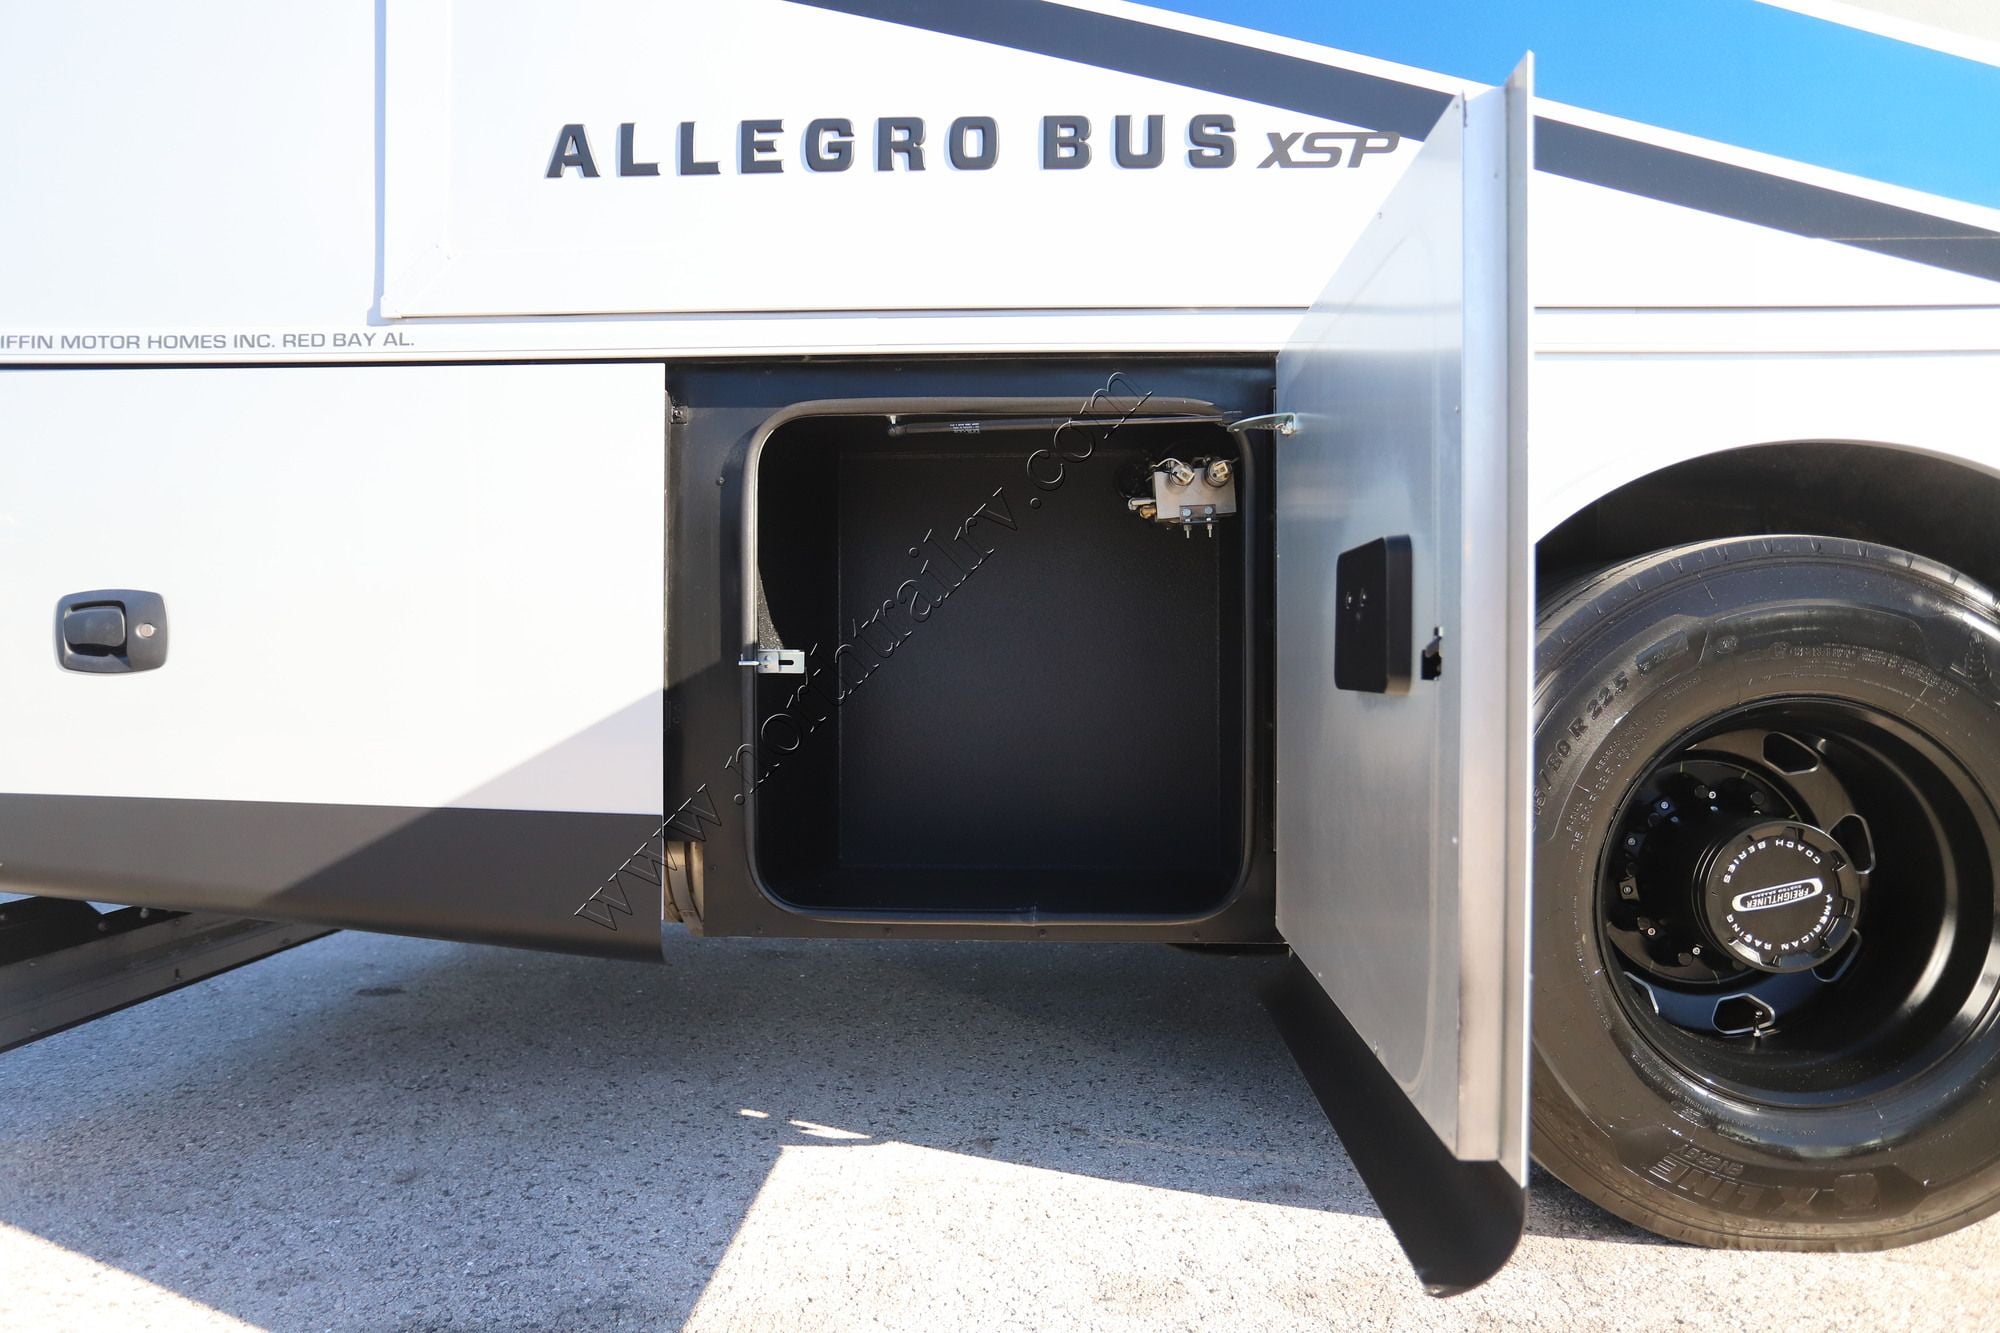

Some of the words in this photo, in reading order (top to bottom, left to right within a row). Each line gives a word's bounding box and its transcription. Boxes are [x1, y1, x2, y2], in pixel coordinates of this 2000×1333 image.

[545, 115, 1000, 178] ALLEGRO
[1040, 113, 1238, 171] BUS
[1256, 131, 1401, 169] XSP
[0, 335, 53, 349] IFFIN
[61, 334, 141, 349] MOTOR
[148, 334, 227, 349] HOMES
[233, 333, 276, 349] INC.
[283, 333, 326, 348] RED
[333, 332, 377, 348] BAY
[383, 331, 415, 347] AL.
[1723, 840, 1767, 884] SERIES
[1775, 839, 1821, 865] COACH
[1746, 887, 1809, 908] FREIGHTLINER
[1726, 913, 1772, 951] RACING
[1780, 893, 1833, 951] AMERICAN
